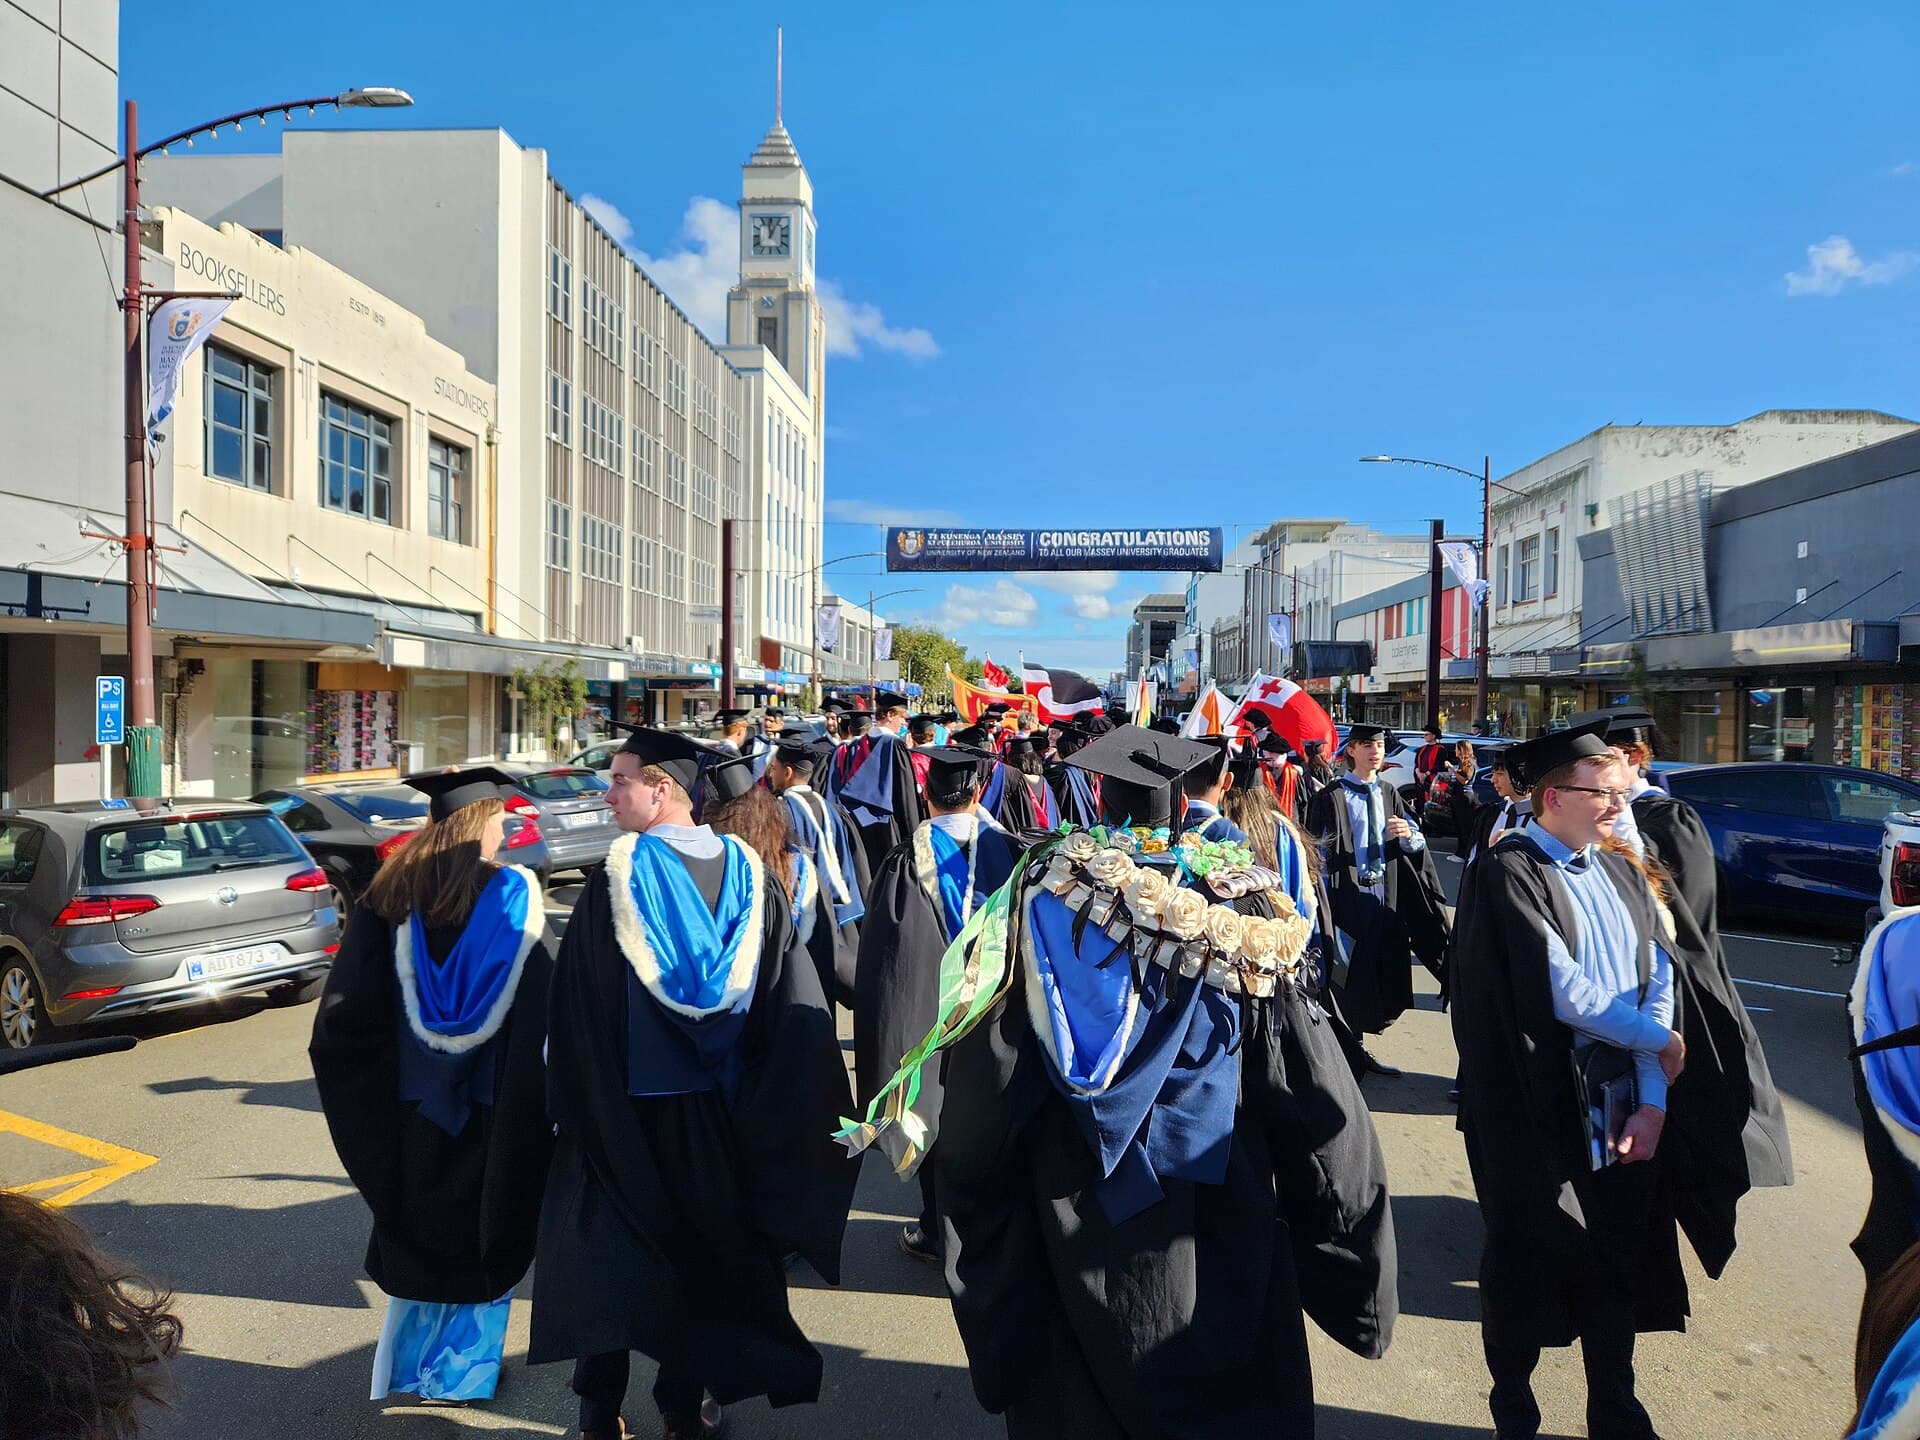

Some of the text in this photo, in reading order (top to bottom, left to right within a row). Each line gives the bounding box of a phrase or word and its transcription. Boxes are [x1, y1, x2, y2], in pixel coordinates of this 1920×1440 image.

[180, 241, 286, 316] BOOKSELLERS
[434, 376, 489, 418] STATIONERS
[987, 532, 1025, 540] MASSEY
[1039, 530, 1211, 546] CONGRATULATIONS
[1038, 547, 1209, 557] TO ALL OUR MASSEY UNIVERSITY GRADUATES
[207, 949, 265, 973] ADT873
